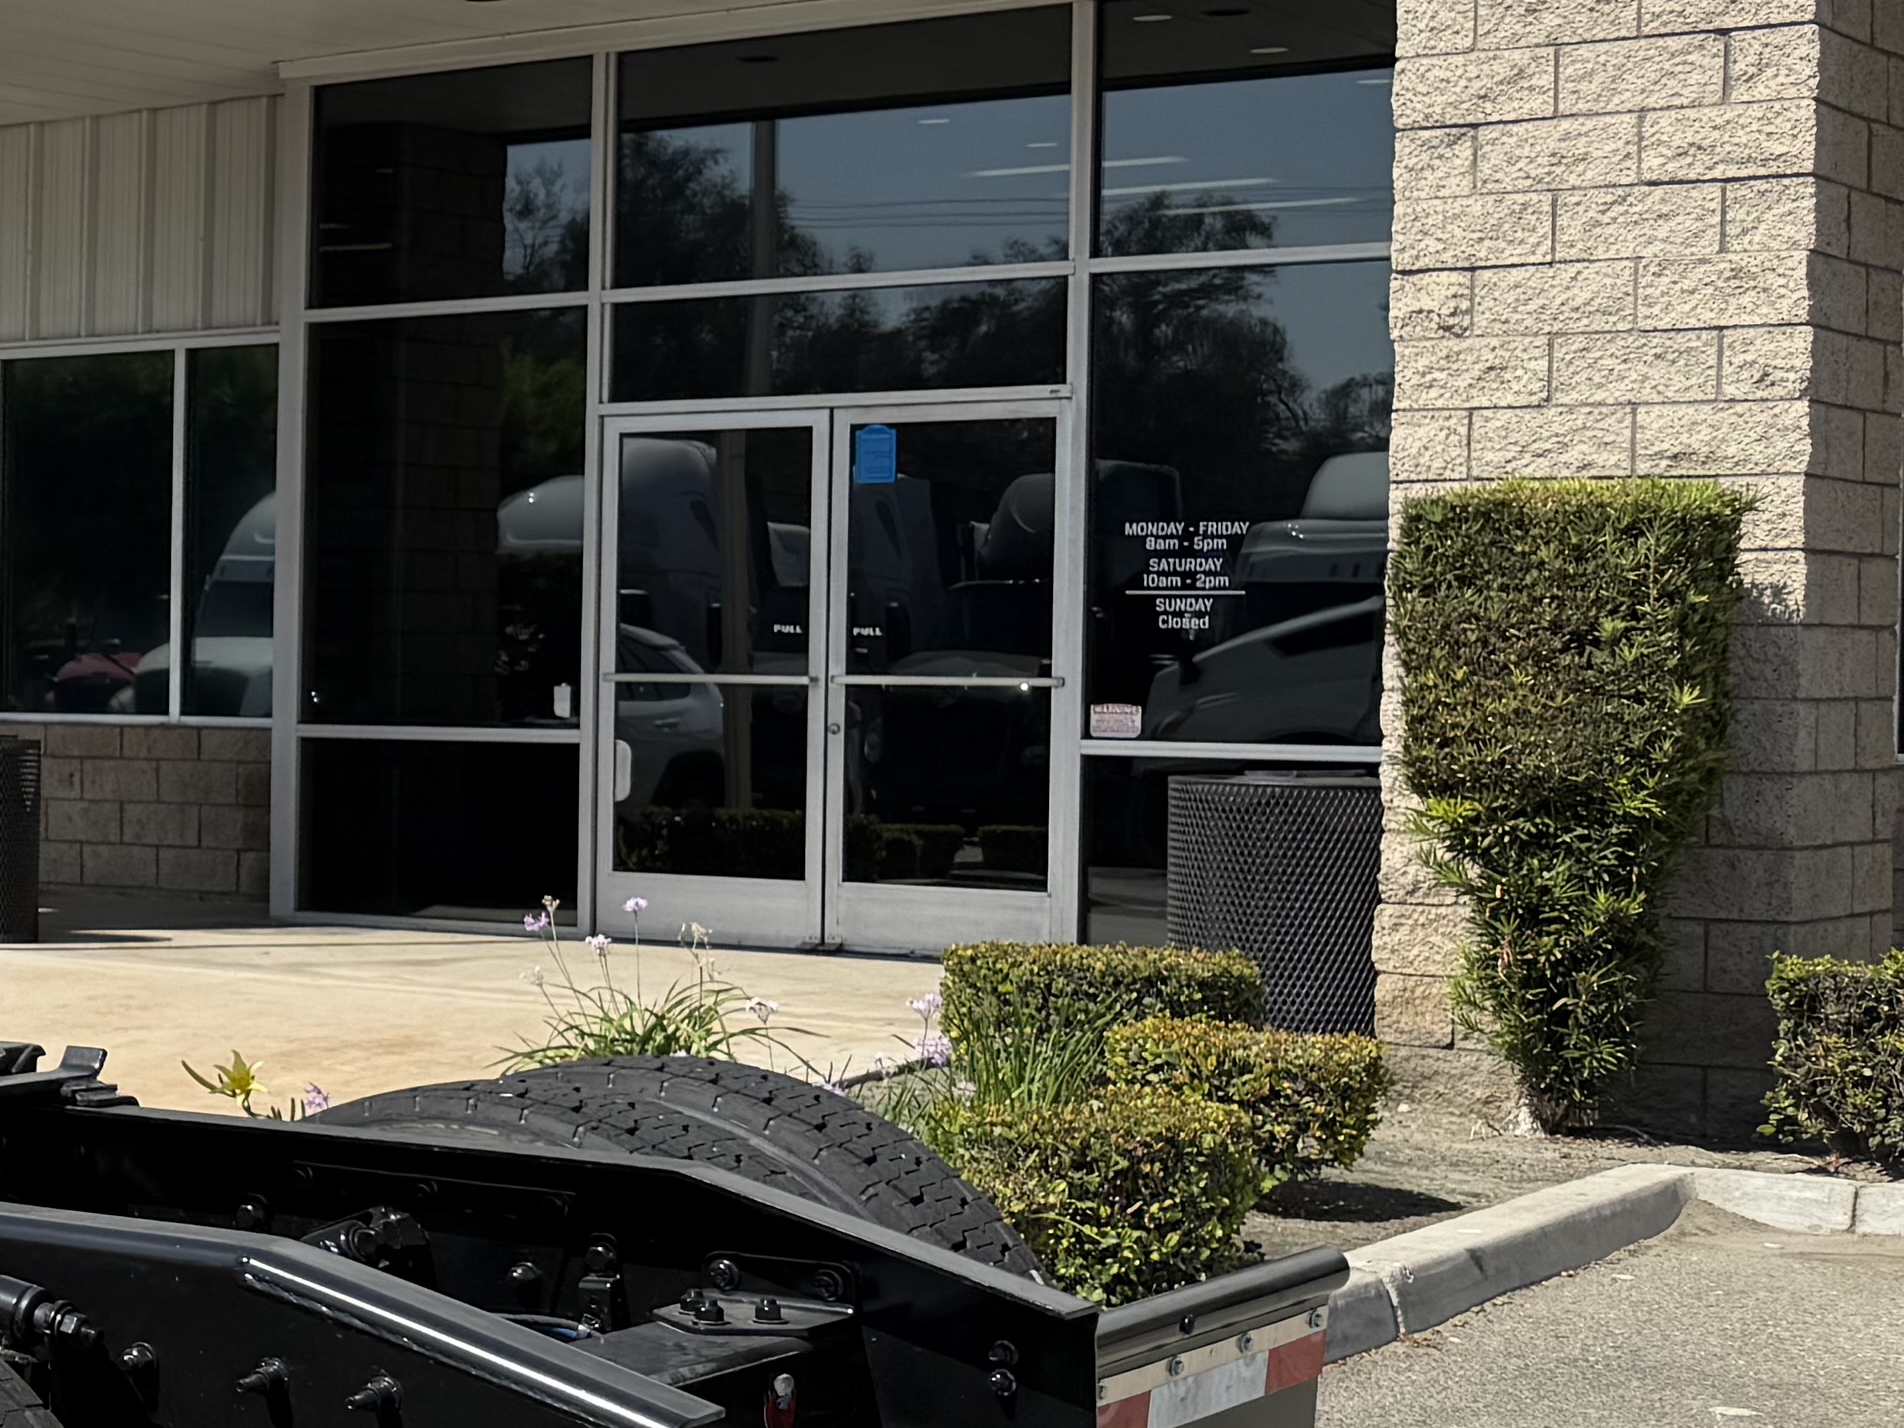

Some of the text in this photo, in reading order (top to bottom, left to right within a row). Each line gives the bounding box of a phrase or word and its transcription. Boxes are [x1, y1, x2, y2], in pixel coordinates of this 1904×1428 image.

[1124, 522, 1185, 536] MONDAY
[1198, 522, 1250, 535] FRIDAY
[1145, 537, 1179, 550] 8am
[1193, 536, 1228, 552] 5pm
[1148, 558, 1224, 571] SATURDAY
[1142, 574, 1181, 588] 10am
[1195, 575, 1230, 590] 2pm
[1155, 598, 1214, 612] SUNDAY
[773, 624, 803, 634] PULL
[1158, 615, 1209, 629] Closed
[852, 627, 883, 636] PULL
